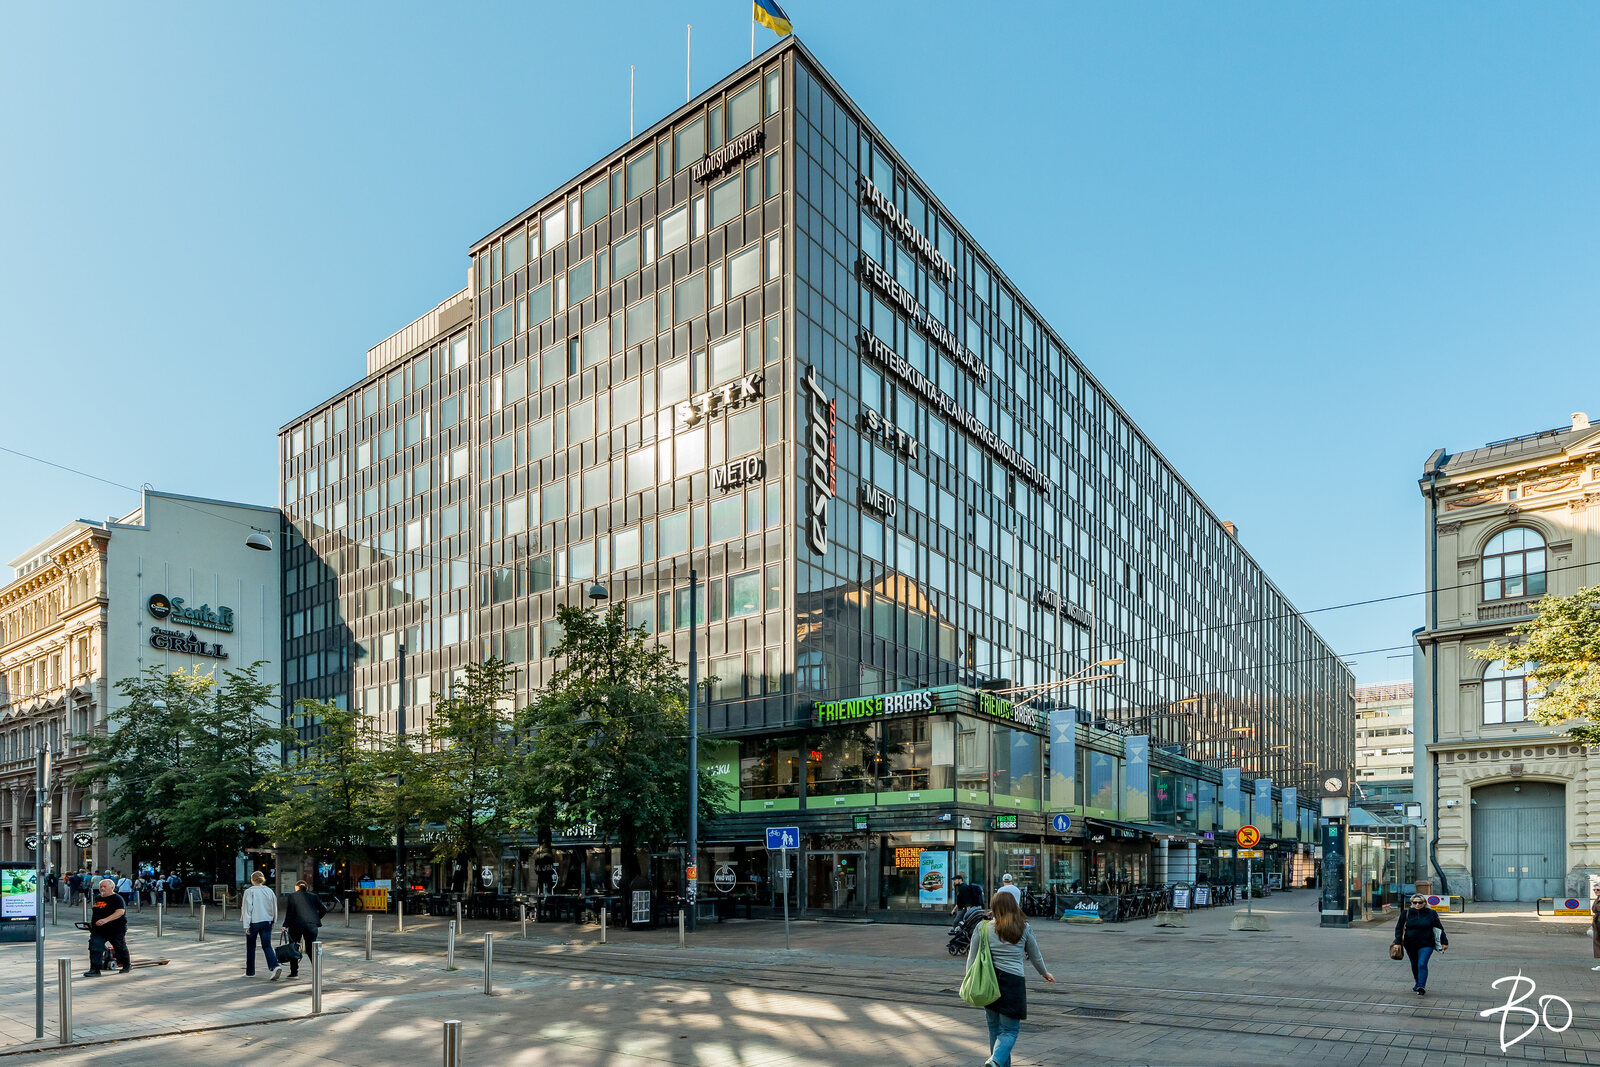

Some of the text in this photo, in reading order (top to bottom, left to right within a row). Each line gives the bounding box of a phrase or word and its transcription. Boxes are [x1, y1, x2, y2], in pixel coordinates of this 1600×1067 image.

[692, 129, 760, 182] TALOUSJURISTIT
[865, 175, 957, 283] TALOUSJURISTIT
[865, 256, 990, 384] FERENDA ASIANAJAJAT
[678, 374, 758, 423] STTK
[866, 331, 965, 425] YHTEISKUNTA-ALAN
[965, 411, 1043, 487] KORKEAKOULUTETUT
[867, 409, 918, 459] STTK
[712, 455, 759, 489] METO
[866, 484, 896, 517] METO
[171, 597, 218, 622] Santa
[818, 699, 874, 722] FRIENDS
[885, 691, 932, 714] BRGRS
[979, 694, 1010, 720] FRIENDS
[901, 858, 920, 867] BRGR
[1074, 901, 1099, 911] Asahi
